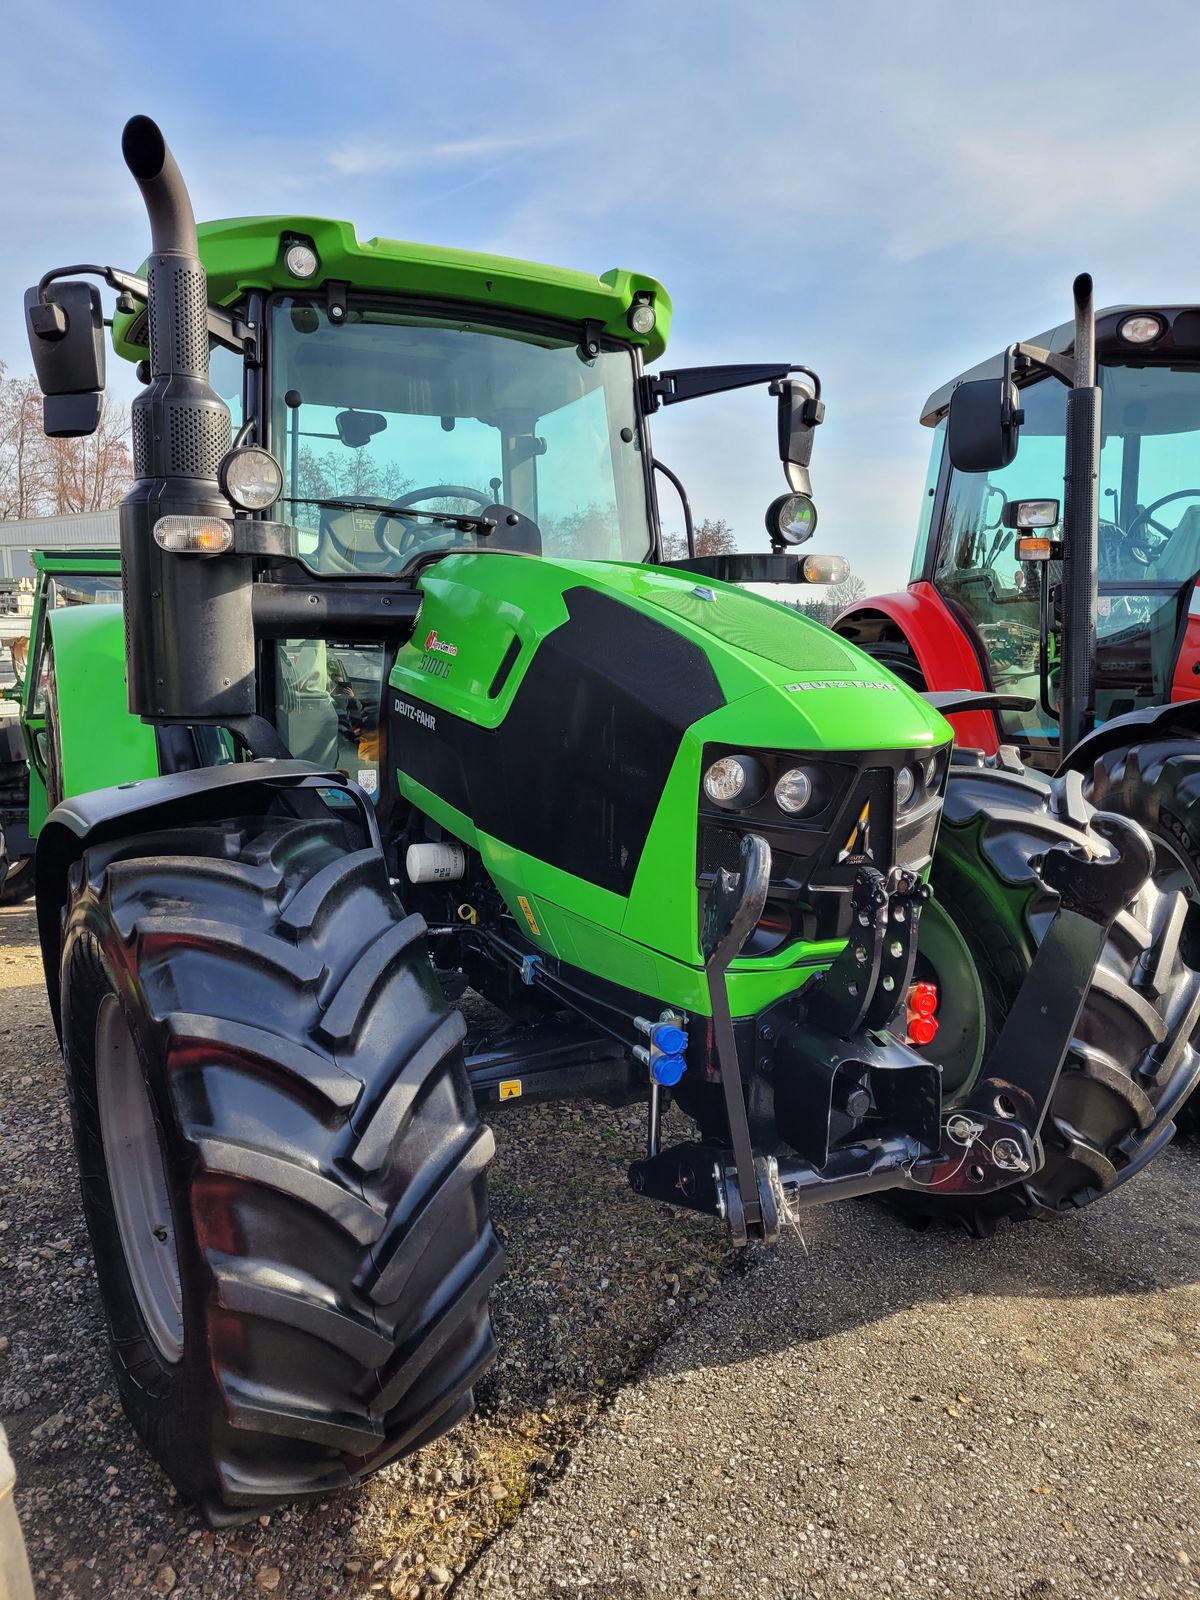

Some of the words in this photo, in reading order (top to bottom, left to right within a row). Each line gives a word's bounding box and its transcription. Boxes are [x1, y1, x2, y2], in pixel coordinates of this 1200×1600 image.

[418, 654, 445, 676] 5100
[784, 680, 898, 693] DEUTZ-FAHR
[394, 698, 436, 731] DEUTZ-FAHR
